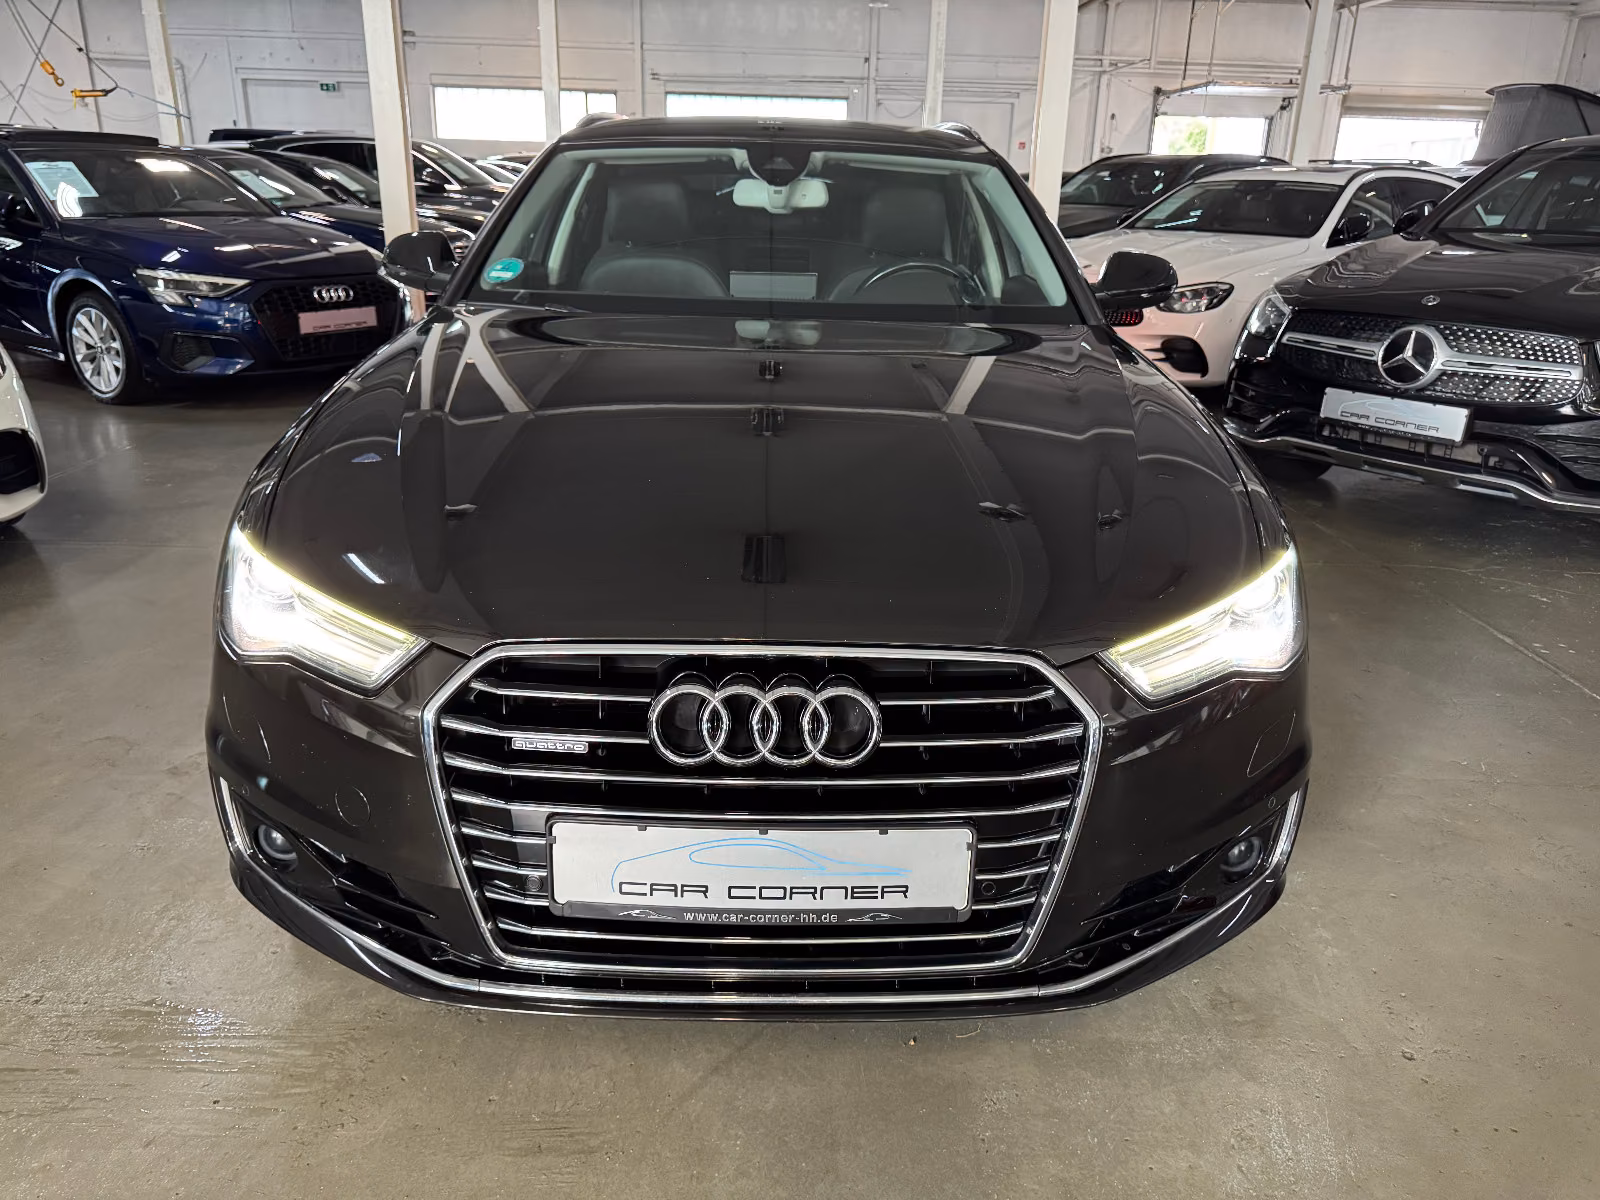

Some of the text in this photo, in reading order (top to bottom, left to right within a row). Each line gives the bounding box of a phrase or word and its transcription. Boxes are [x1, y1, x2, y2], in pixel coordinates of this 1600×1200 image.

[1340, 410, 1370, 421] CAR
[1374, 416, 1440, 434] CORNER
[515, 740, 585, 751] quattro
[619, 881, 909, 900] CAR CORNER
[683, 911, 838, 923] www.car-corner-hh.de
